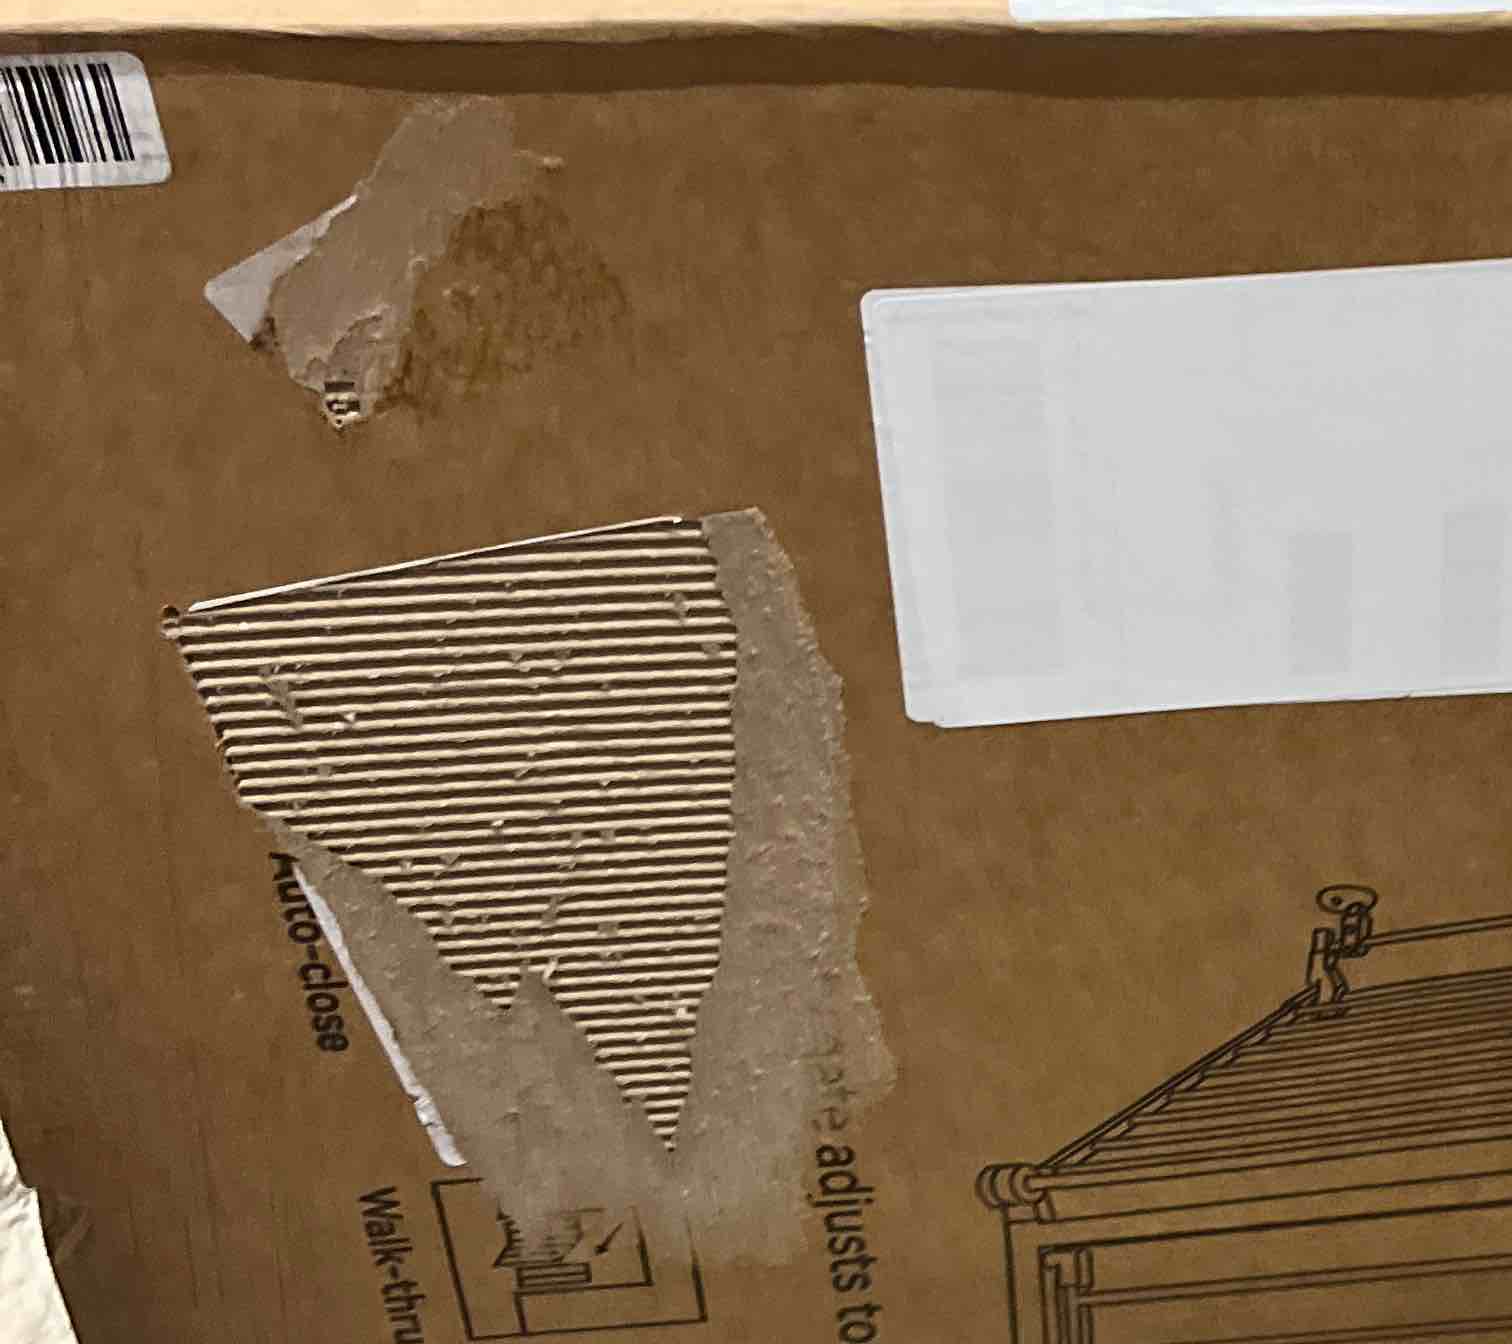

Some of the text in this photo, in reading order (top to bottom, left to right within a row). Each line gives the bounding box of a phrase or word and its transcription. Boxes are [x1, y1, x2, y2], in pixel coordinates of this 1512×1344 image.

[268, 851, 349, 1052] Auto-close
[805, 1144, 877, 1293] adjusts
[836, 1303, 882, 1344] to
